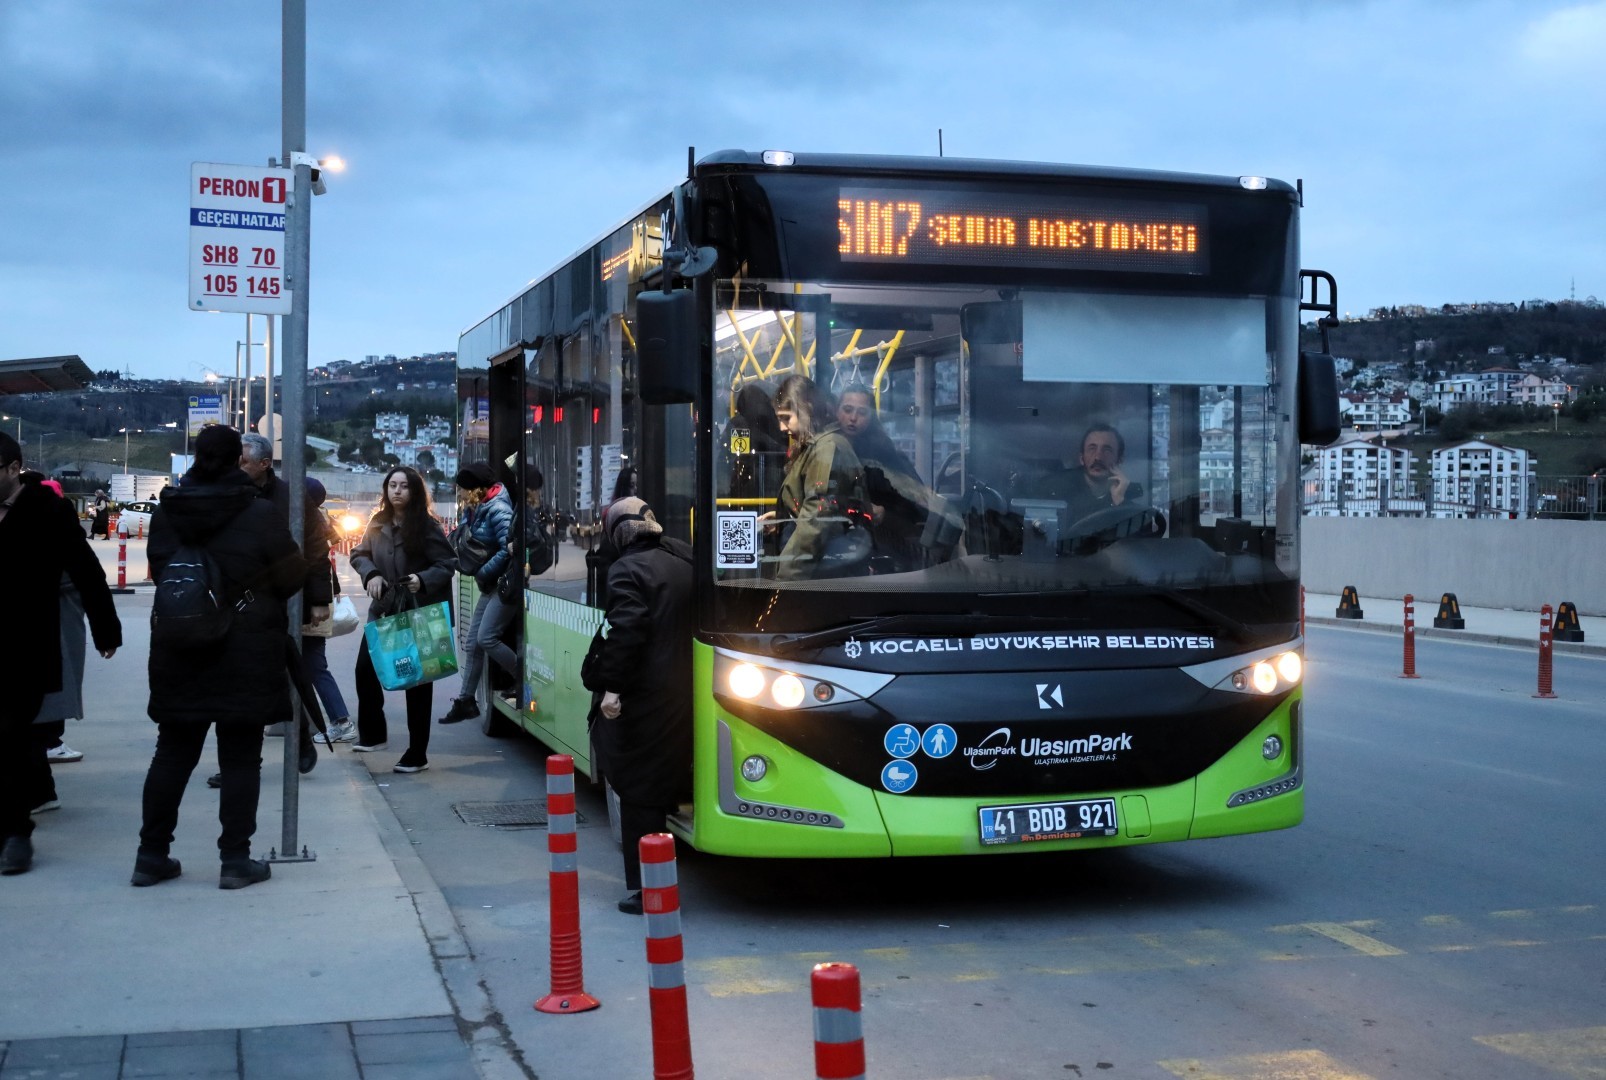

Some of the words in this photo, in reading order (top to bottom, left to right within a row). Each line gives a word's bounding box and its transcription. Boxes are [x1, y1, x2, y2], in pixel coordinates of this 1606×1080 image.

[199, 177, 260, 198] PERON
[267, 180, 280, 201] 1
[198, 211, 238, 227] GEÇEN
[838, 200, 921, 255] SH17
[203, 244, 239, 264] SH8
[251, 247, 276, 266] 70
[203, 274, 238, 293] 105
[246, 276, 280, 295] 145
[984, 825, 994, 833] TR
[994, 810, 1016, 835] 41
[1028, 807, 1067, 832] BDB
[1079, 803, 1113, 829] 921
